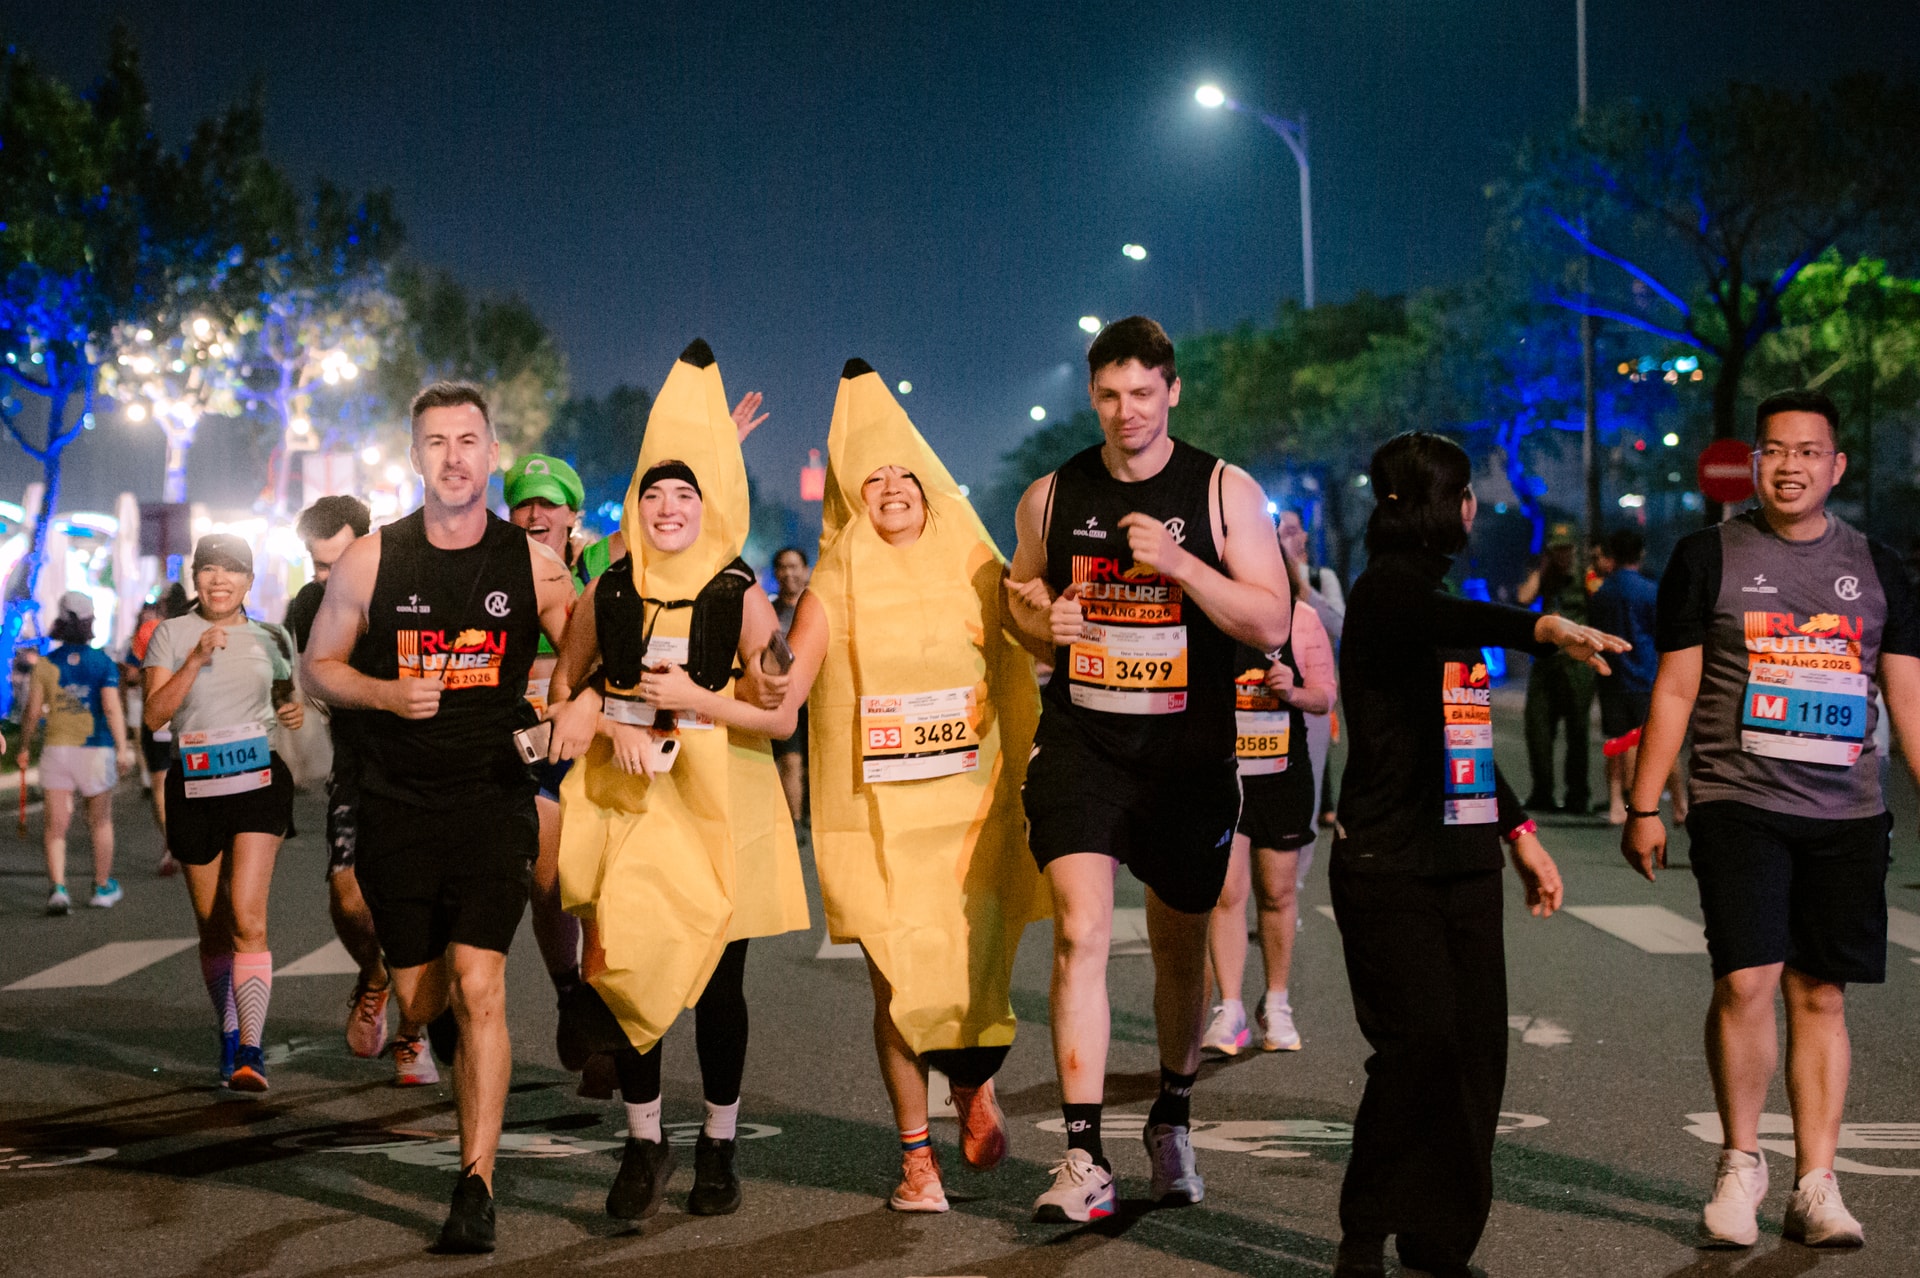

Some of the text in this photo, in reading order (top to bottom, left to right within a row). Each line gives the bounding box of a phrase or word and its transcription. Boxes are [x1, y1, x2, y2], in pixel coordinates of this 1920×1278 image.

[1081, 581, 1169, 603] FUTURE
[1140, 607, 1171, 619] 2026
[1755, 636, 1848, 655] FUTURE
[1076, 654, 1173, 680] B3 3499
[1822, 659, 1852, 671] 2026
[463, 673, 492, 685] 2026
[1756, 695, 1852, 726] M 1189
[869, 721, 966, 749] B3 3482
[1236, 736, 1279, 751] 3585
[190, 746, 258, 770] F 1104
[1456, 760, 1471, 783] F
